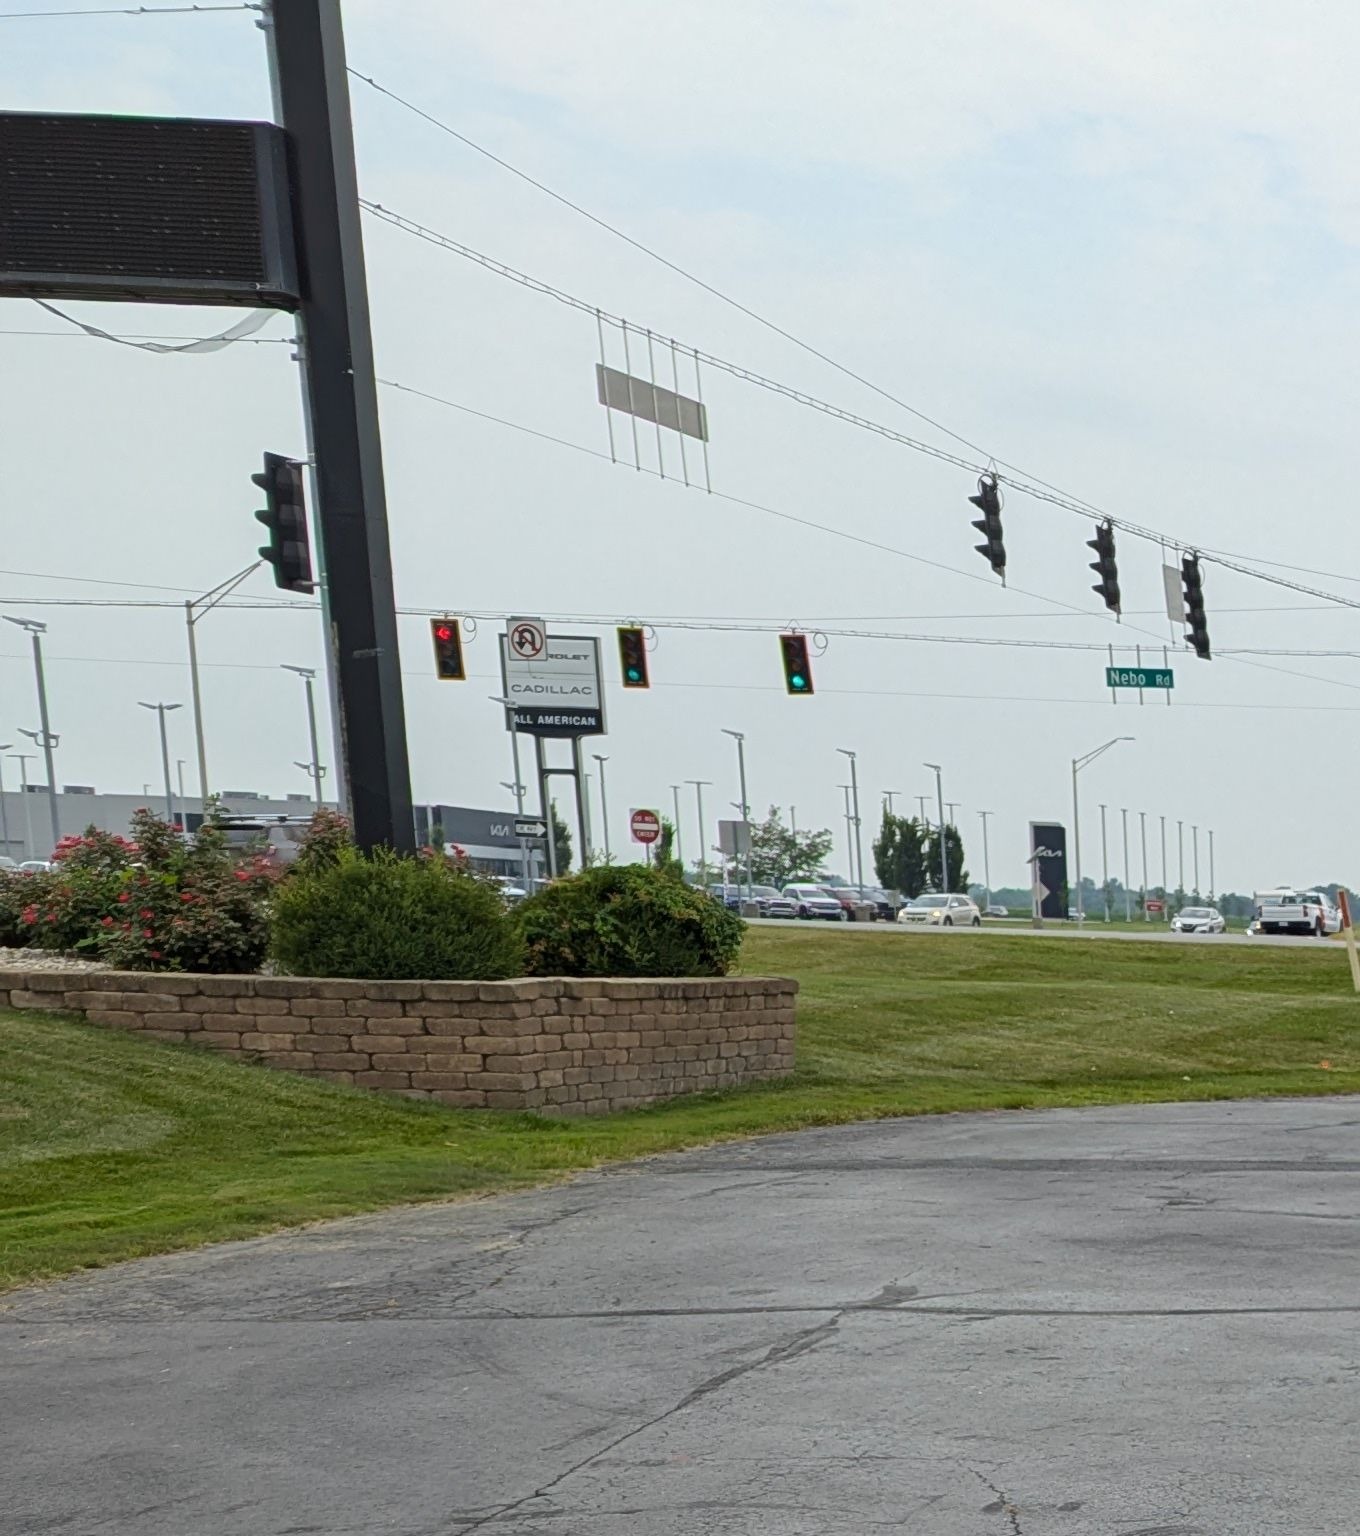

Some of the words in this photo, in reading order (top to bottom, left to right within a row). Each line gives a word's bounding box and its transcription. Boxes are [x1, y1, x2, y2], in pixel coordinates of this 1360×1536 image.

[1110, 670, 1146, 685] Nebo
[1155, 674, 1170, 686] Rd
[511, 684, 592, 695] CADILLAC
[513, 715, 533, 724] ALL
[537, 715, 597, 726] AMERICAN
